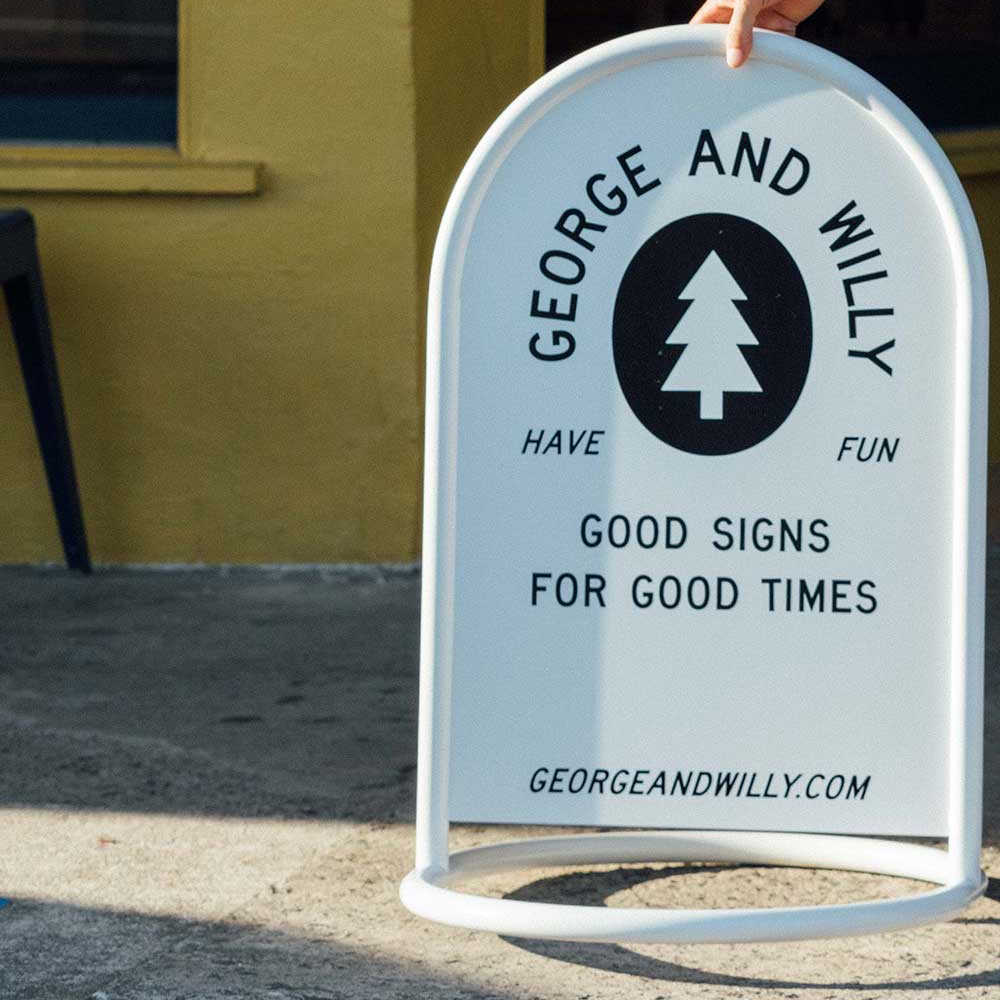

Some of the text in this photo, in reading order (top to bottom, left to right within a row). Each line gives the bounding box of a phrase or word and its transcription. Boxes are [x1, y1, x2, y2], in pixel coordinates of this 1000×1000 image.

[528, 129, 896, 377] GEORGE AND WILLY
[521, 429, 900, 463] HAVE FUN
[580, 514, 831, 553] GOOD SIGNS
[531, 572, 878, 614] FOR GOOD TIMES
[529, 767, 872, 801] GEORGEANDWILLY.COM
